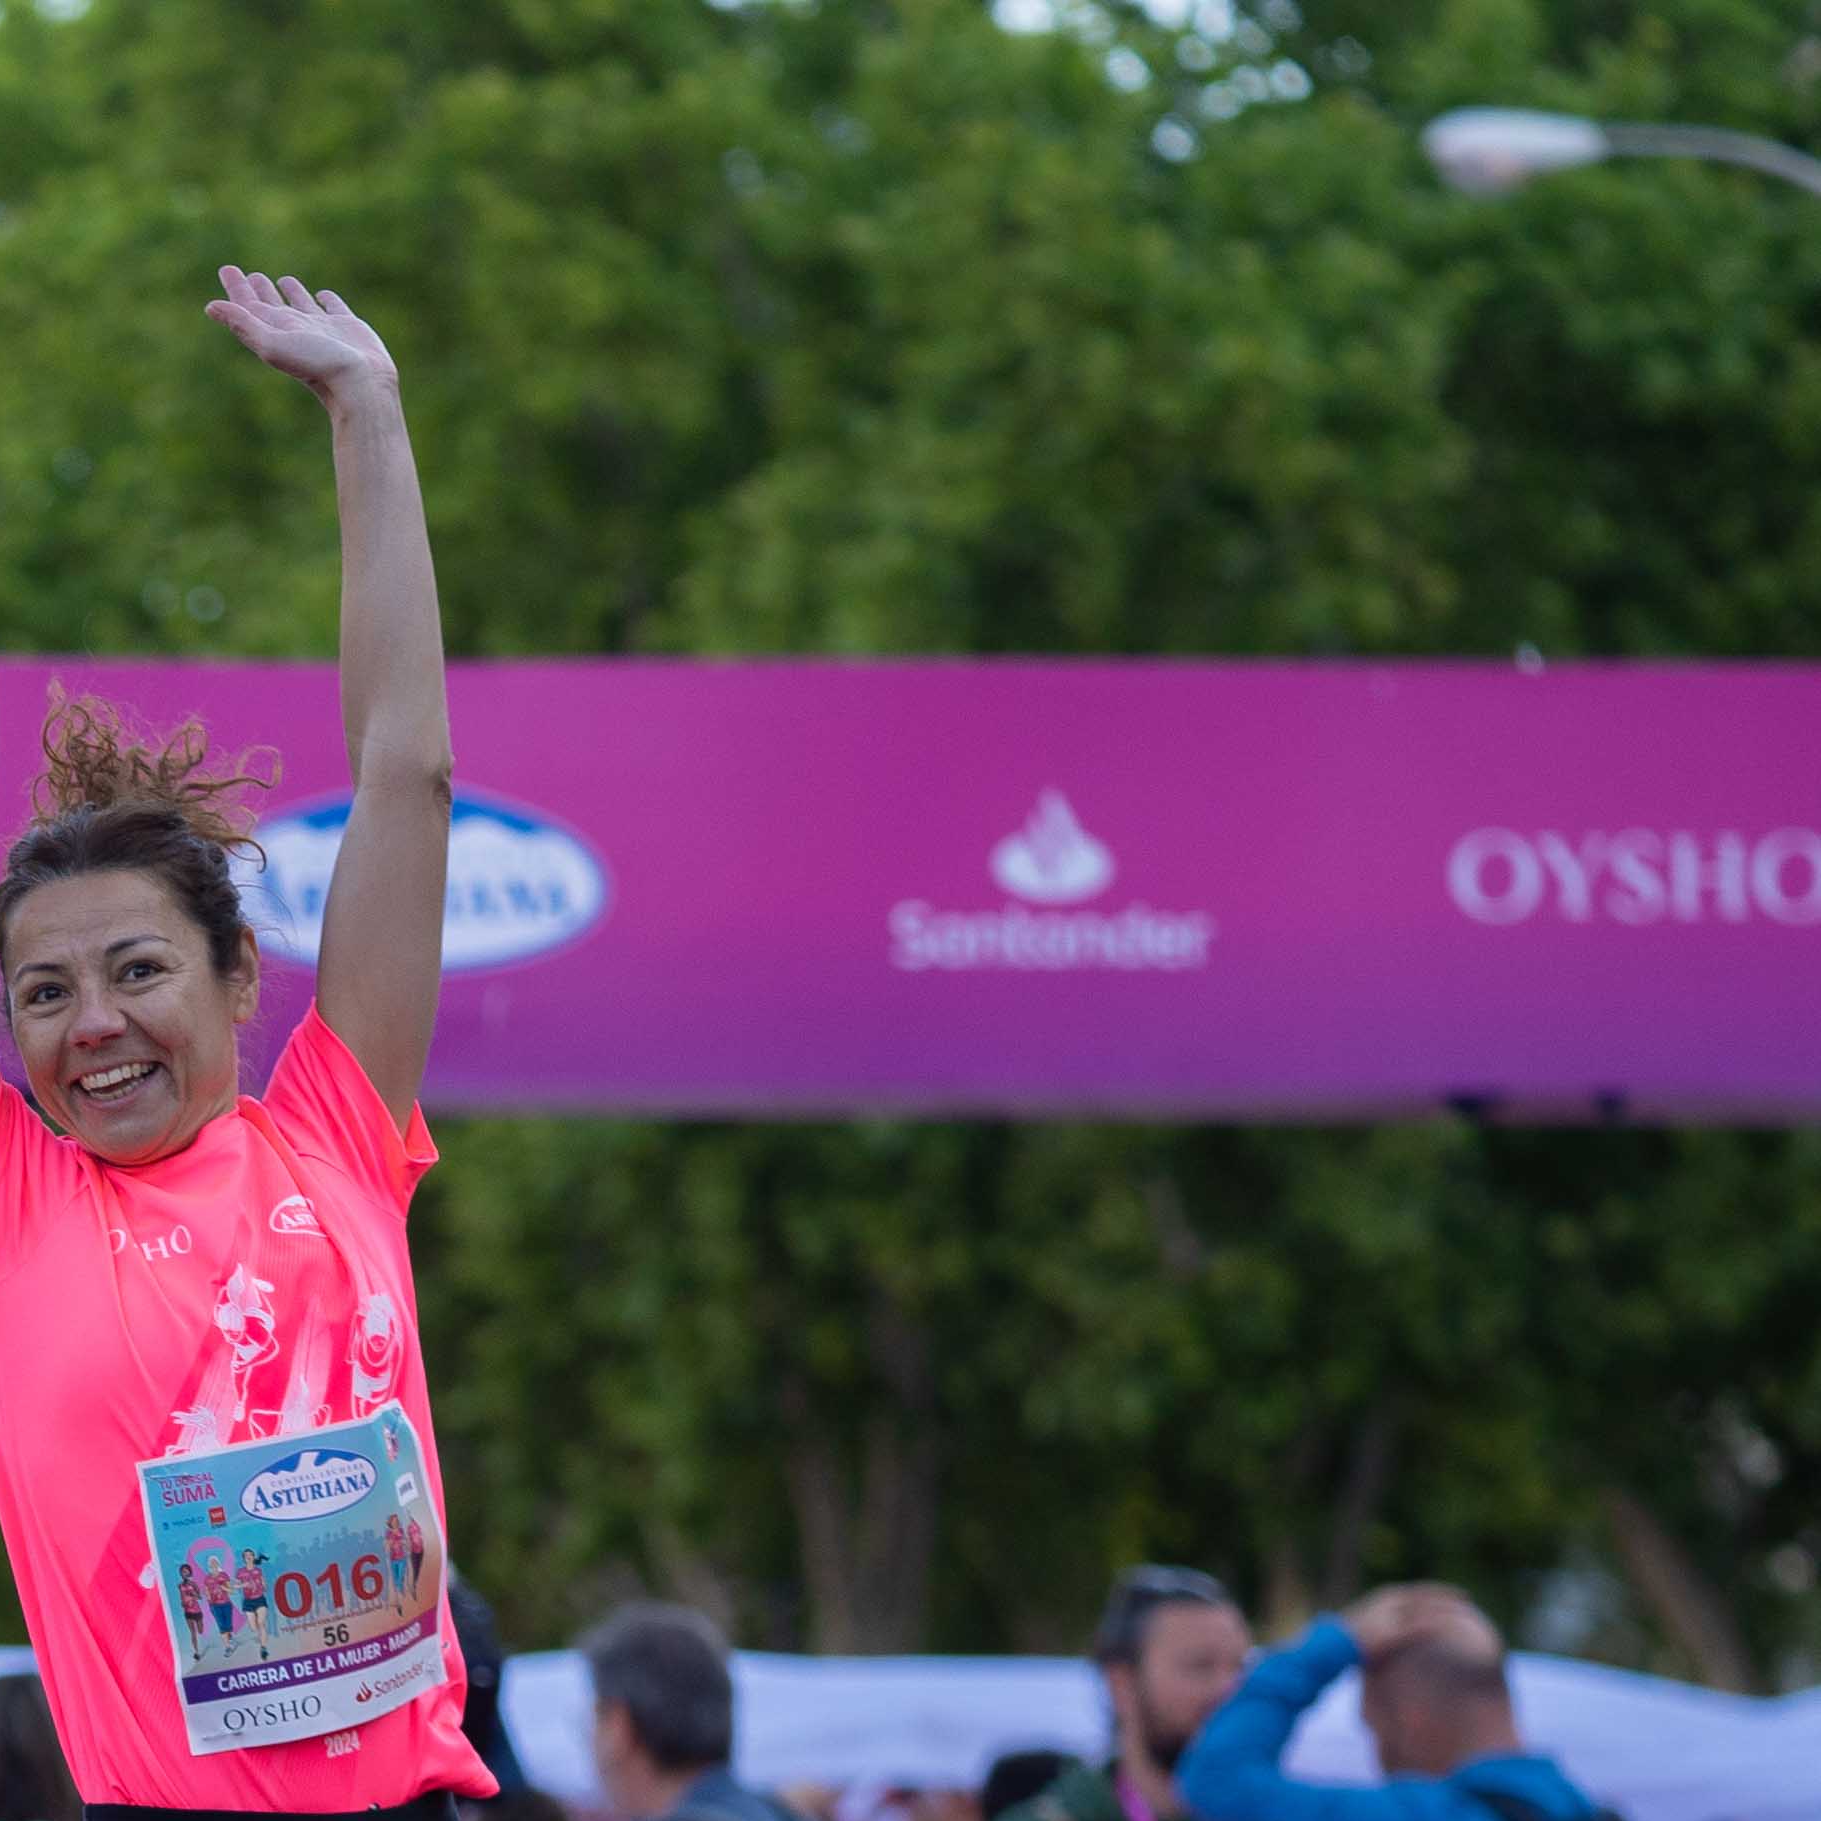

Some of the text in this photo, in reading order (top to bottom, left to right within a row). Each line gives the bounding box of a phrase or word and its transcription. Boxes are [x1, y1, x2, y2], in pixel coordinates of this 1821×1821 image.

[1447, 826, 1821, 926] OYSHO
[162, 1483, 217, 1507] SUMA
[252, 1471, 371, 1512] ASTURIANA
[274, 1554, 384, 1618] 016
[323, 1623, 350, 1647] 56
[218, 1665, 289, 1693] CARRERA
[293, 1661, 315, 1679] DE
[317, 1655, 335, 1674] LA
[339, 1643, 382, 1668] MUJER
[223, 1695, 322, 1731] OYSHO
[324, 1731, 361, 1759] 2024
